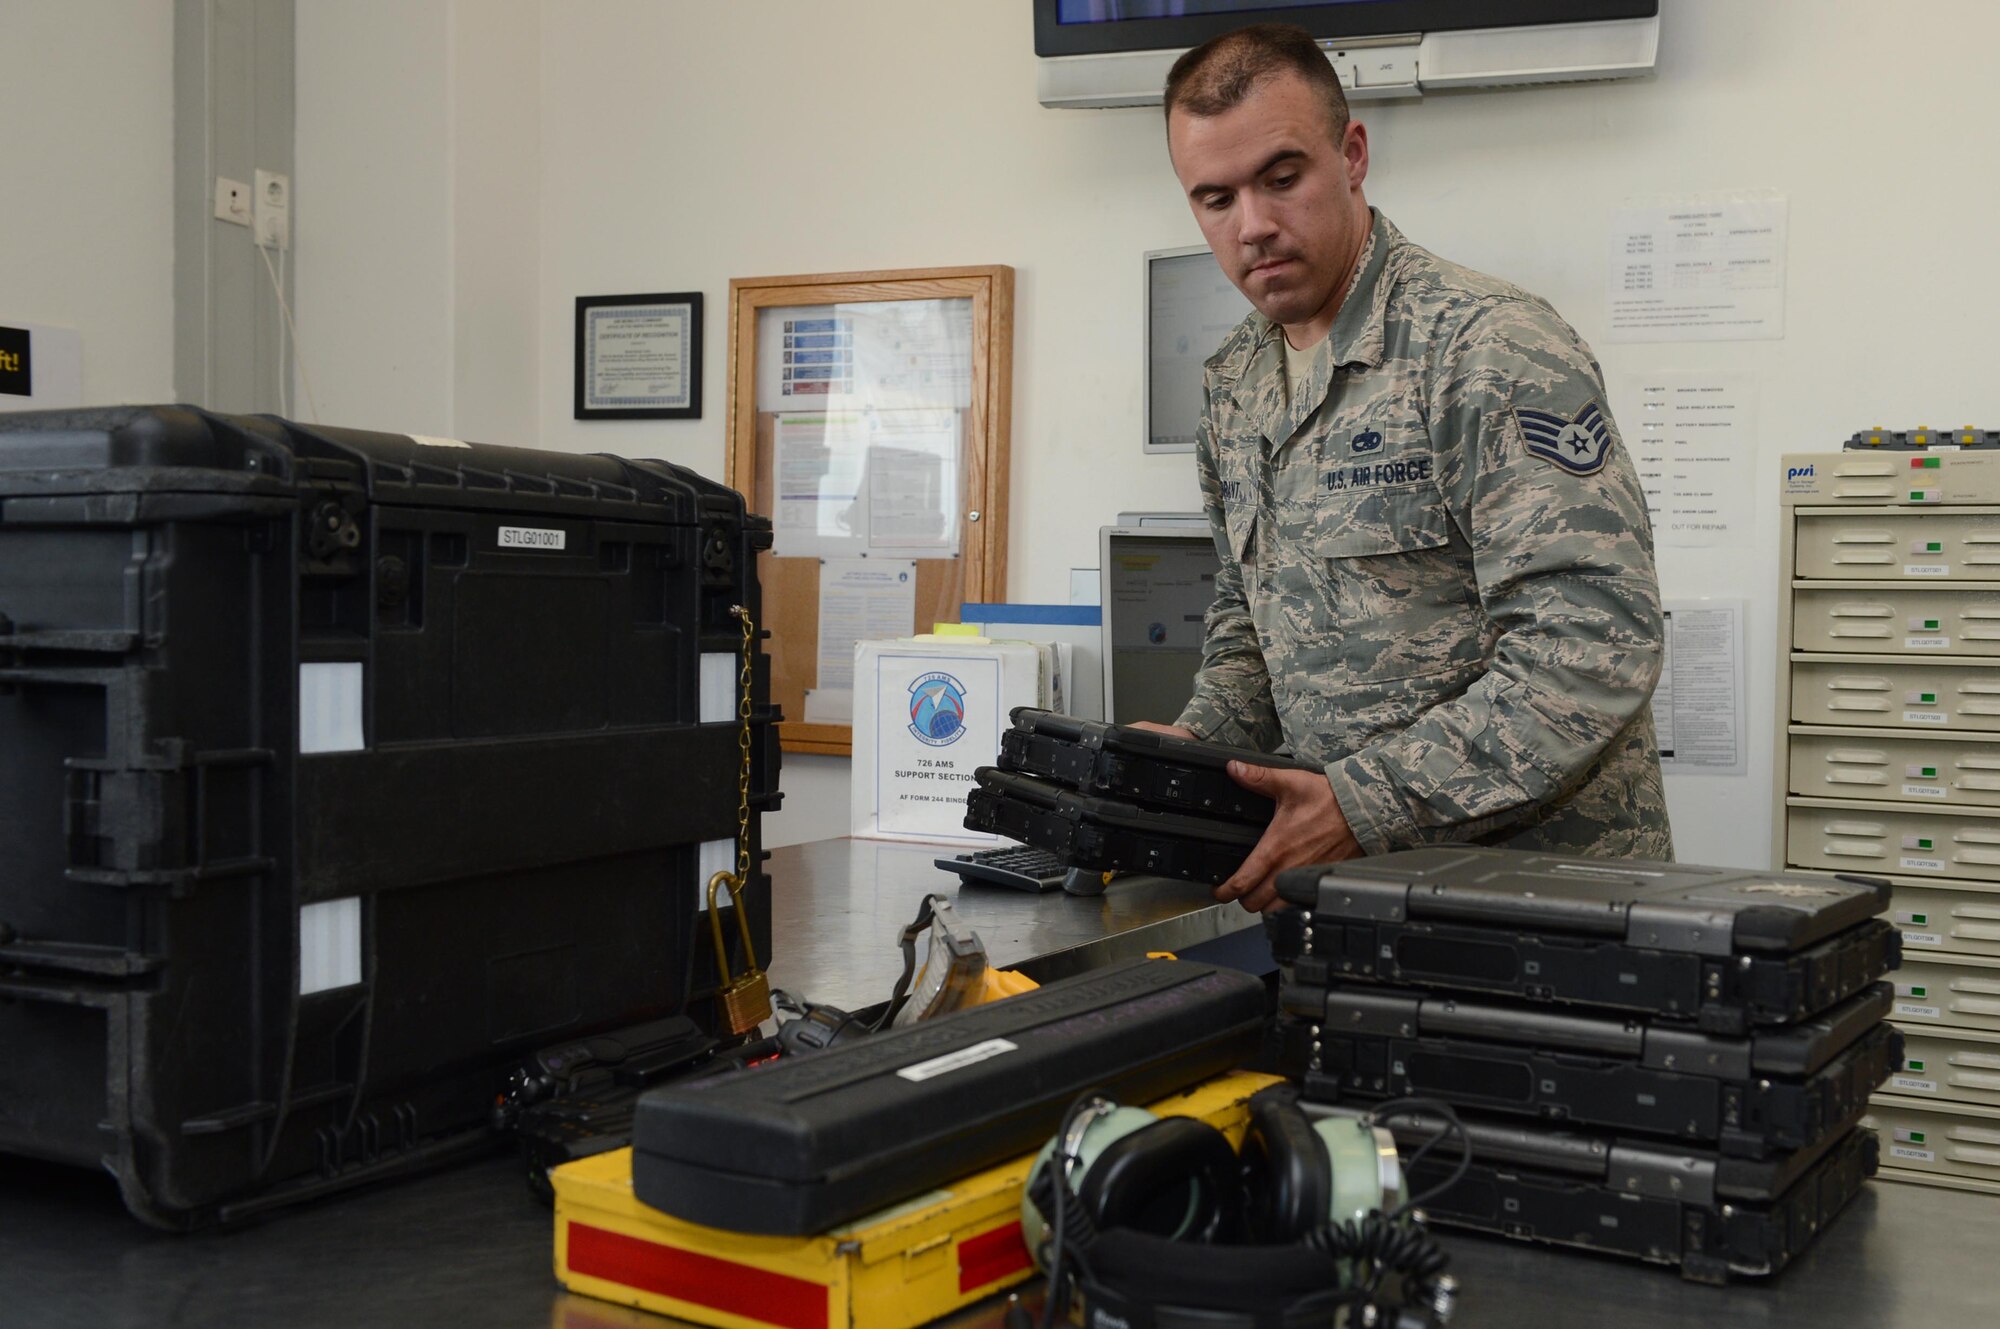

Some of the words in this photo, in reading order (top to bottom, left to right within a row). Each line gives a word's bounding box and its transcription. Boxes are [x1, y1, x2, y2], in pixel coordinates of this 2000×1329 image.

[1327, 471, 1347, 491] U.S.
[1351, 466, 1371, 487] AIR
[1375, 459, 1431, 484] FORCE
[917, 759, 933, 767] 726
[934, 760, 955, 769] AMS
[894, 770, 936, 780] SUPPORT
